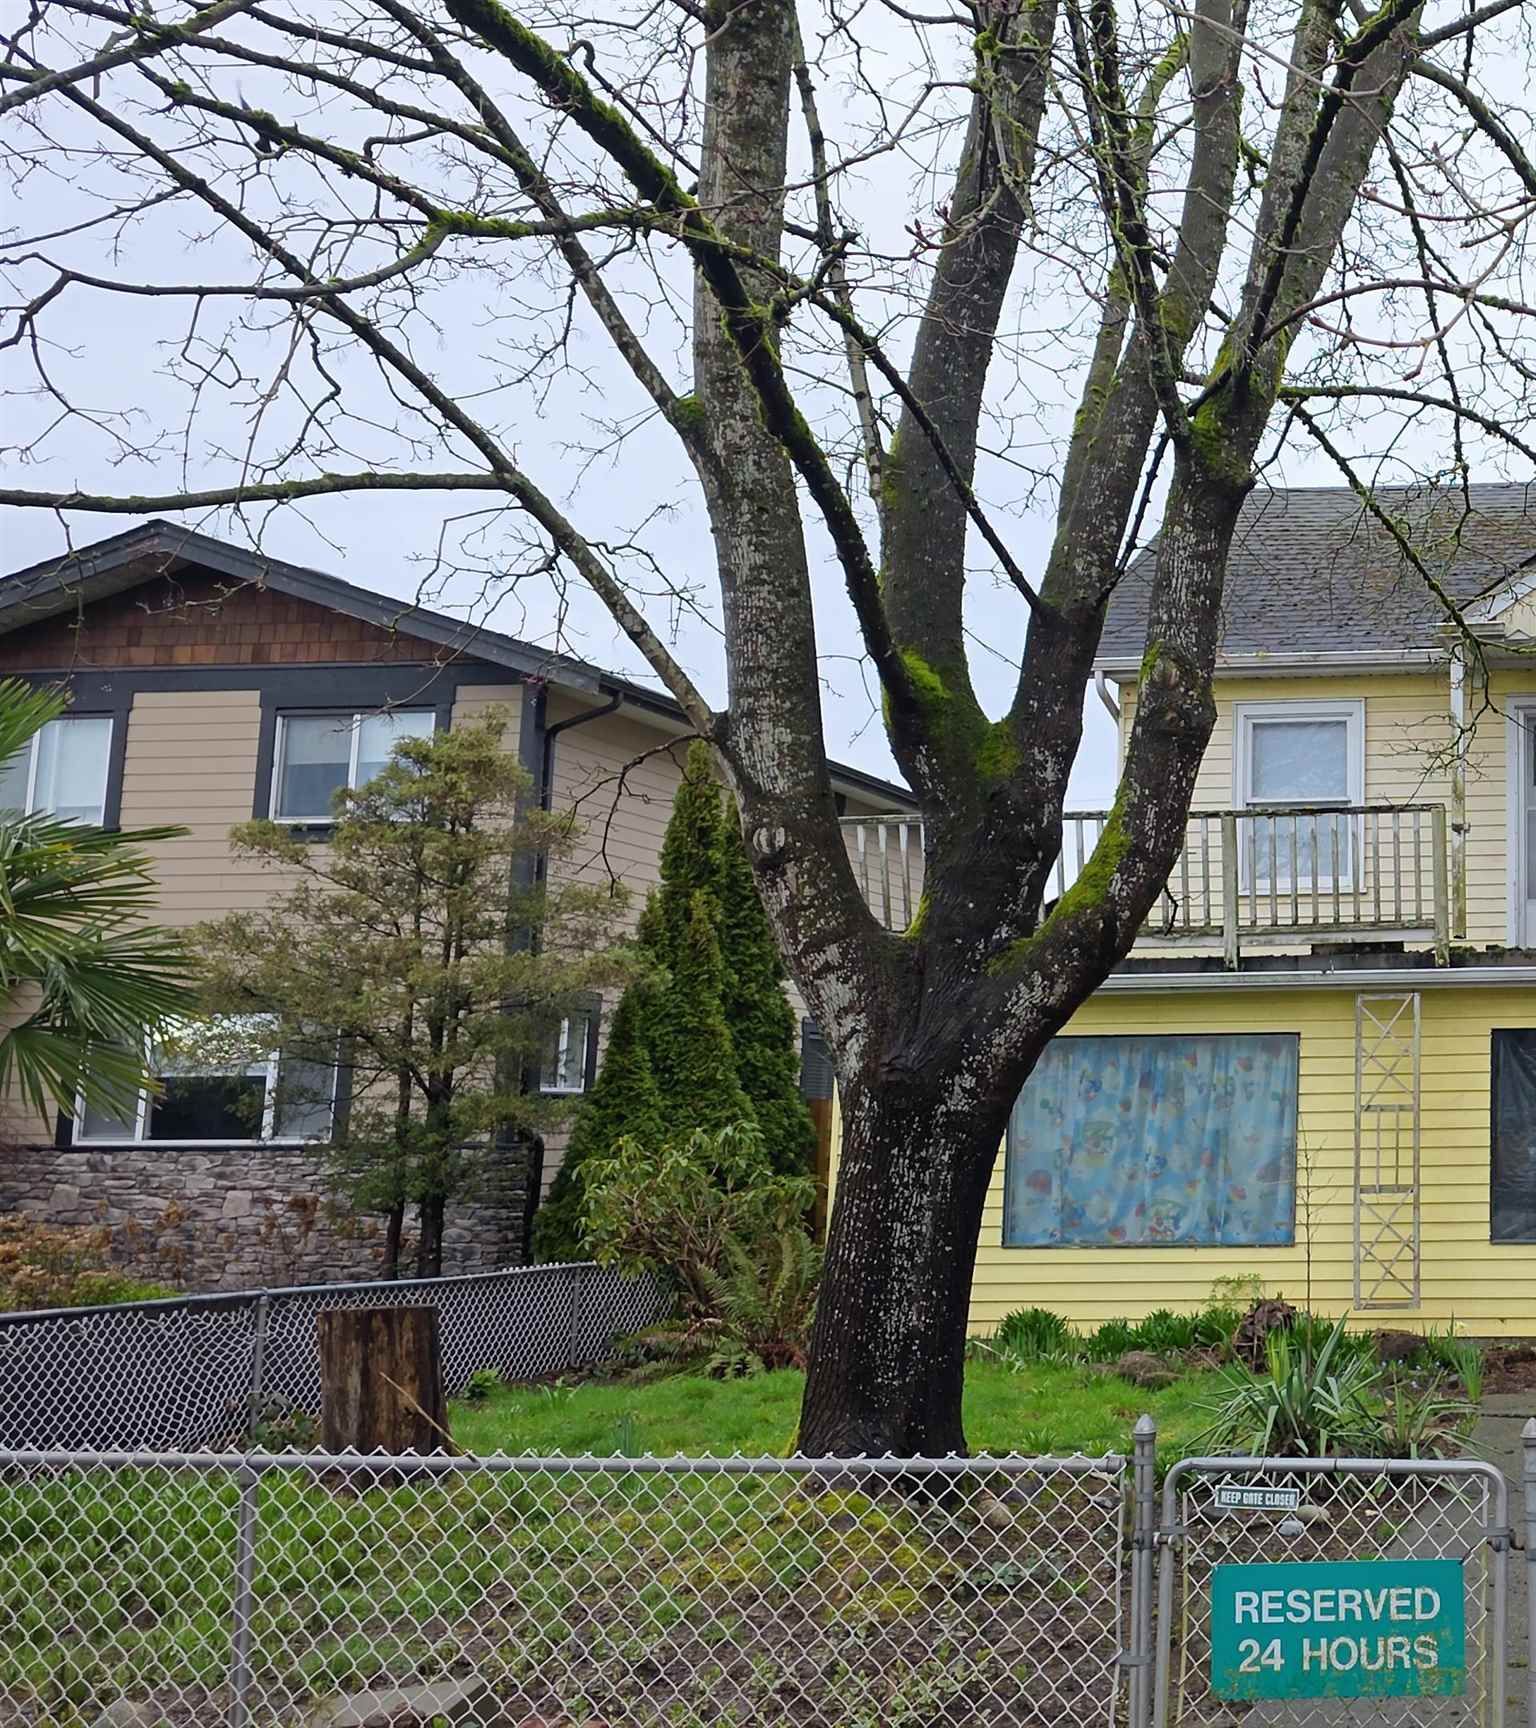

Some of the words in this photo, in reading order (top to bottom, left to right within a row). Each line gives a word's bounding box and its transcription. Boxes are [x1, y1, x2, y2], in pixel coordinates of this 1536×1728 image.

[1220, 1491, 1241, 1504] KEEP
[1243, 1492, 1263, 1505] GATE
[1265, 1493, 1296, 1506] CLOSED
[1235, 1588, 1441, 1624] RESERVED
[1239, 1639, 1285, 1673] 24
[1303, 1636, 1439, 1671] HOURS
